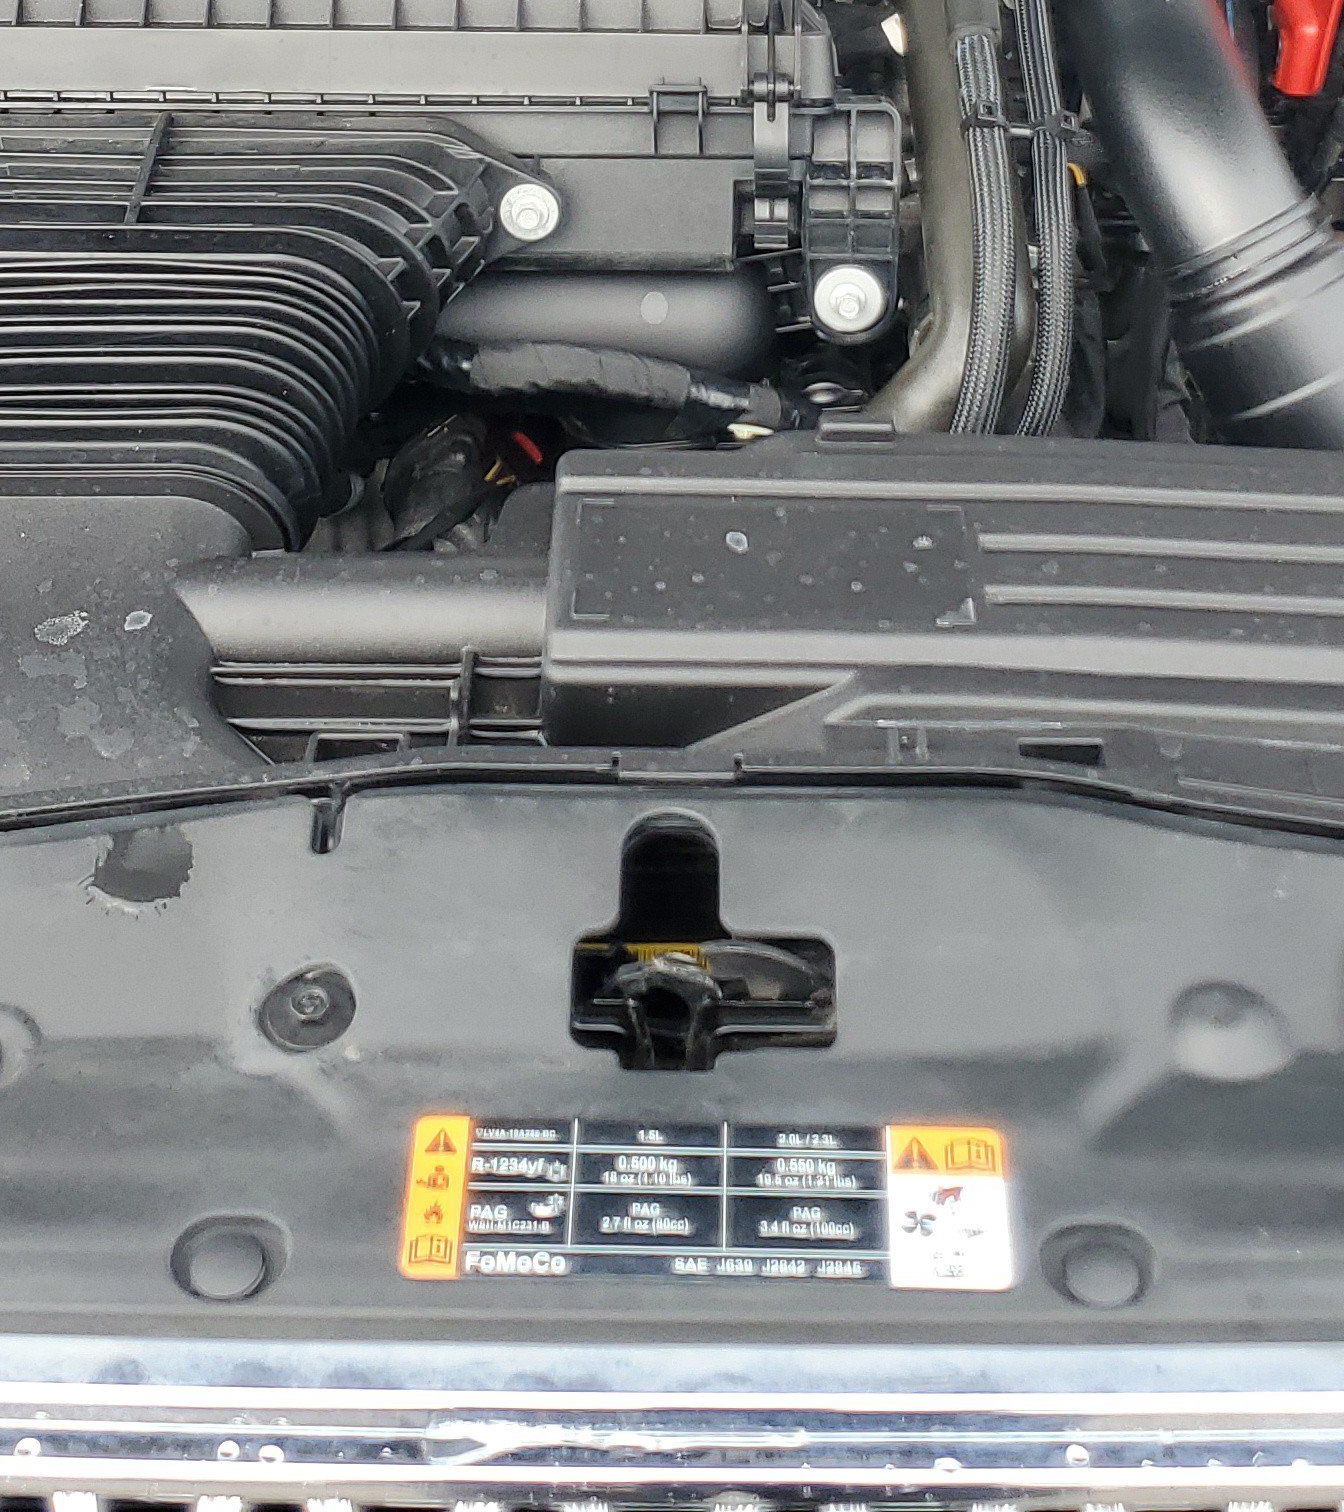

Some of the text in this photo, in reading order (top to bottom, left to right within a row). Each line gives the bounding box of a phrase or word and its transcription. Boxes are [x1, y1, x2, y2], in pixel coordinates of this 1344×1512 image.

[471, 1158, 545, 1176] R-1234yf
[618, 1155, 678, 1174] 0.500 kg
[818, 1159, 836, 1177] kg
[620, 1173, 636, 1184] oz
[470, 1204, 508, 1220] PAG
[632, 1202, 660, 1215] PAG
[792, 1206, 821, 1219] PAG
[634, 1218, 650, 1230] oz
[792, 1223, 808, 1234] oz
[465, 1251, 566, 1273] FoMoCo
[674, 1256, 708, 1272] SAE
